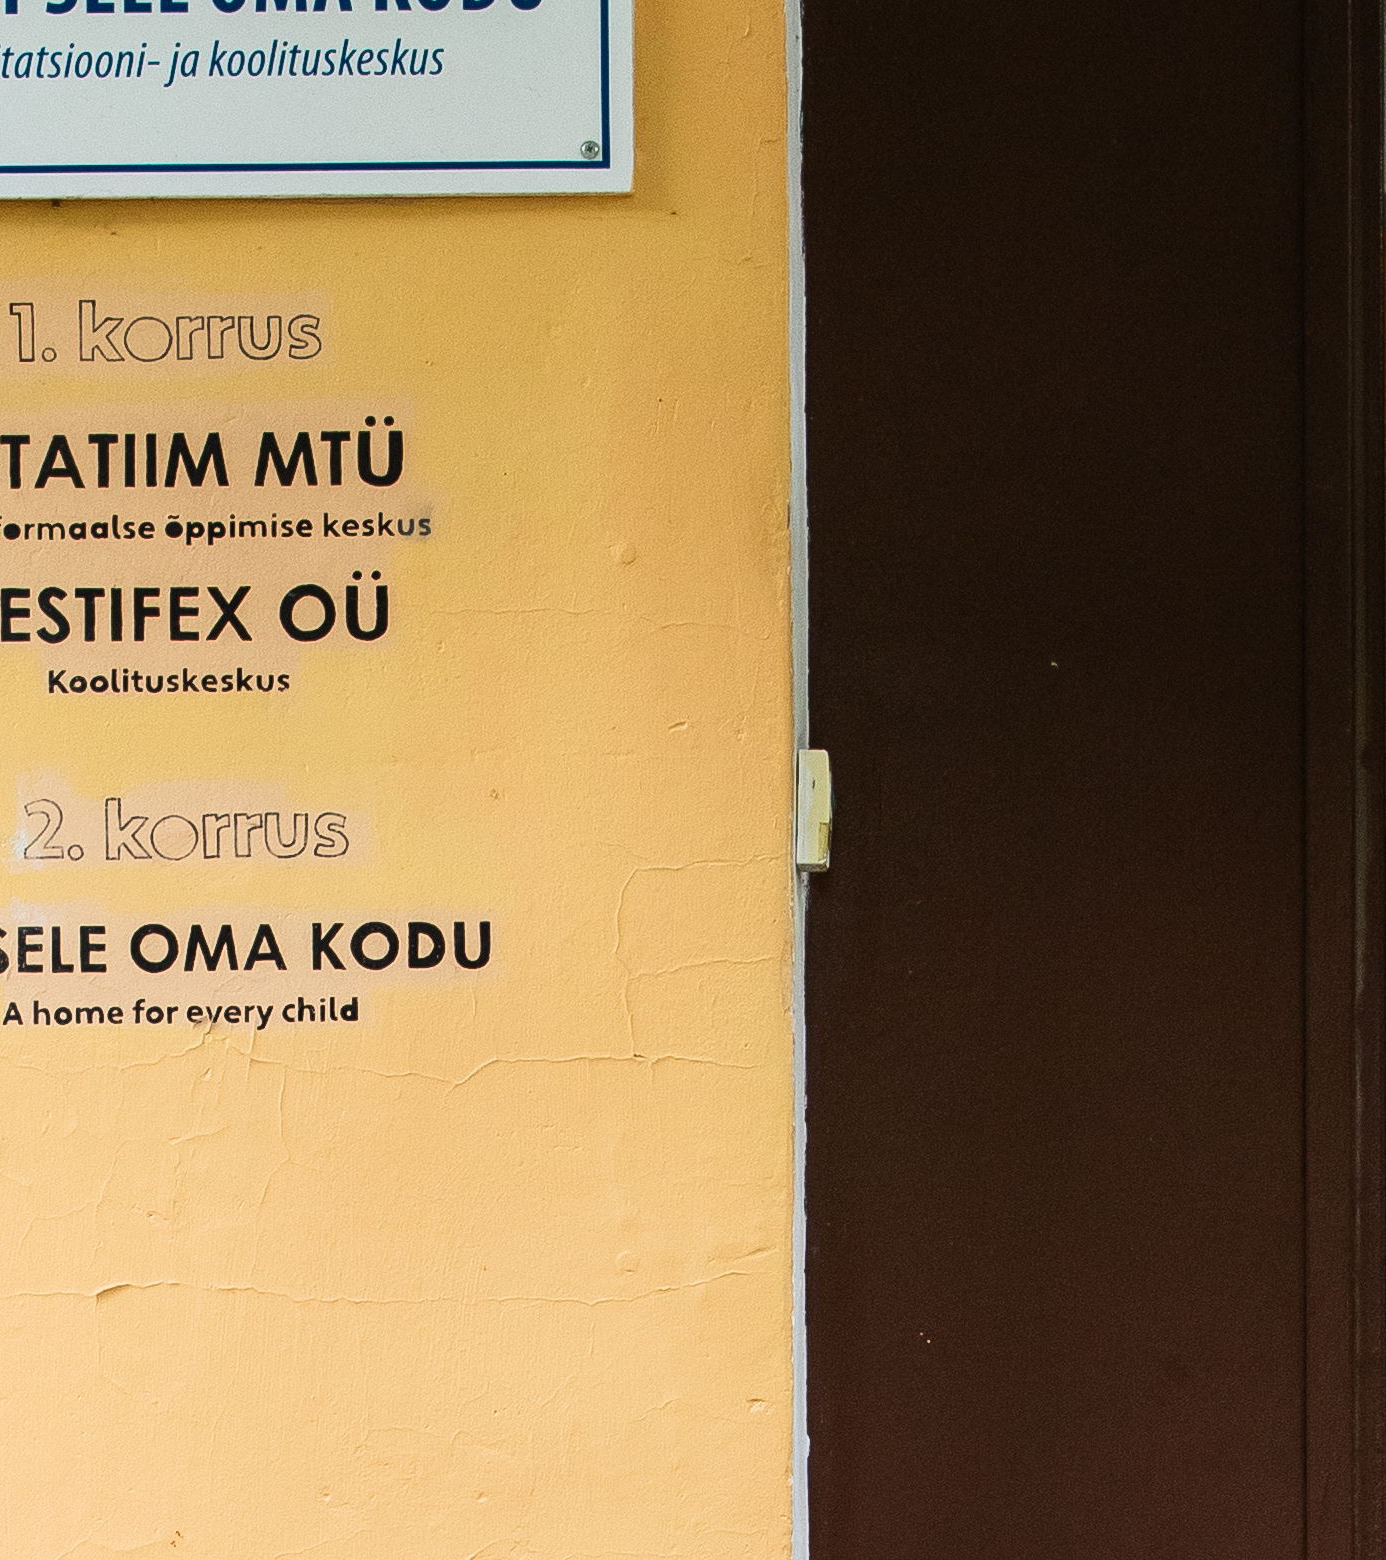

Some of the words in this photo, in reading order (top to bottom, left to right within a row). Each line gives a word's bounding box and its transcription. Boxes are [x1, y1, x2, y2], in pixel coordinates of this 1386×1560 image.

[163, 43, 199, 88] ja
[209, 37, 445, 78] koolituskeskus
[9, 303, 57, 363] 1.
[78, 300, 322, 362] korrus
[254, 415, 405, 487] MTÜ
[164, 514, 314, 547] õppimise
[323, 511, 433, 538] keskus
[279, 570, 390, 642] OÜ
[47, 667, 291, 695] Koolituskeskus
[24, 798, 85, 862] 2.
[104, 797, 350, 861] korrus
[130, 923, 288, 974] OMA
[311, 920, 492, 971] KODU
[2, 1001, 24, 1027] A
[33, 1000, 124, 1026] home
[132, 997, 179, 1025] for
[186, 1004, 275, 1032] every
[281, 996, 360, 1024] child
